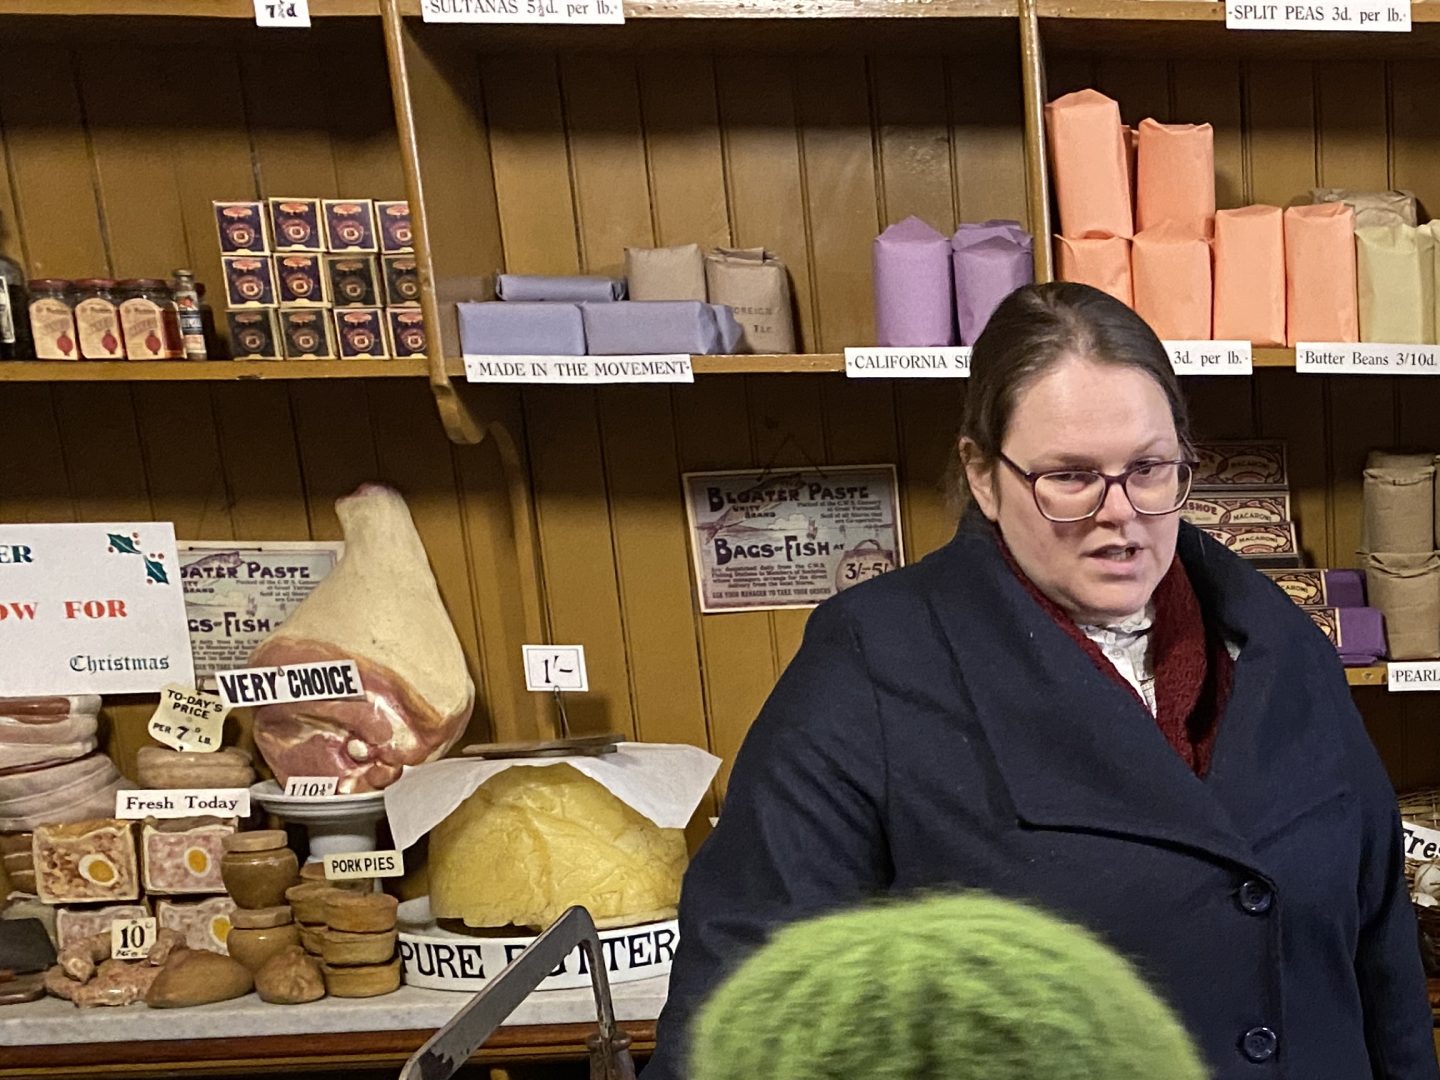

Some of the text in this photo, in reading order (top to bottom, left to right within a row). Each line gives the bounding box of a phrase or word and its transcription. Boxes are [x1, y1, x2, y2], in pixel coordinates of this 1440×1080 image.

[430, 0, 518, 14] SULTANAS
[567, 4, 588, 17] per
[1234, 5, 1278, 20] SPLIT
[1285, 5, 1325, 21] PEAS
[1360, 10, 1381, 24] per
[854, 355, 946, 370] CALIFORNIA
[1200, 354, 1221, 368] per
[1305, 352, 1345, 366] Butter
[1352, 352, 1389, 366] Beans
[479, 360, 687, 376] MADE IN THE MOVEMENT
[809, 482, 870, 501] PASTE
[714, 536, 830, 565] BAGS FISH
[248, 562, 311, 579] PASTE
[64, 600, 128, 619] FOR
[224, 612, 271, 637] FISH
[70, 655, 170, 675] Christmas
[219, 665, 359, 704] VERY CHOICE
[1395, 669, 1440, 683] PEARL
[167, 689, 223, 713] TO-DAY'S
[172, 702, 210, 720] PRICE
[152, 722, 171, 734] PER
[126, 795, 239, 811] Fresh Today
[332, 856, 395, 873] PORK PIES
[399, 940, 485, 979] PURE
